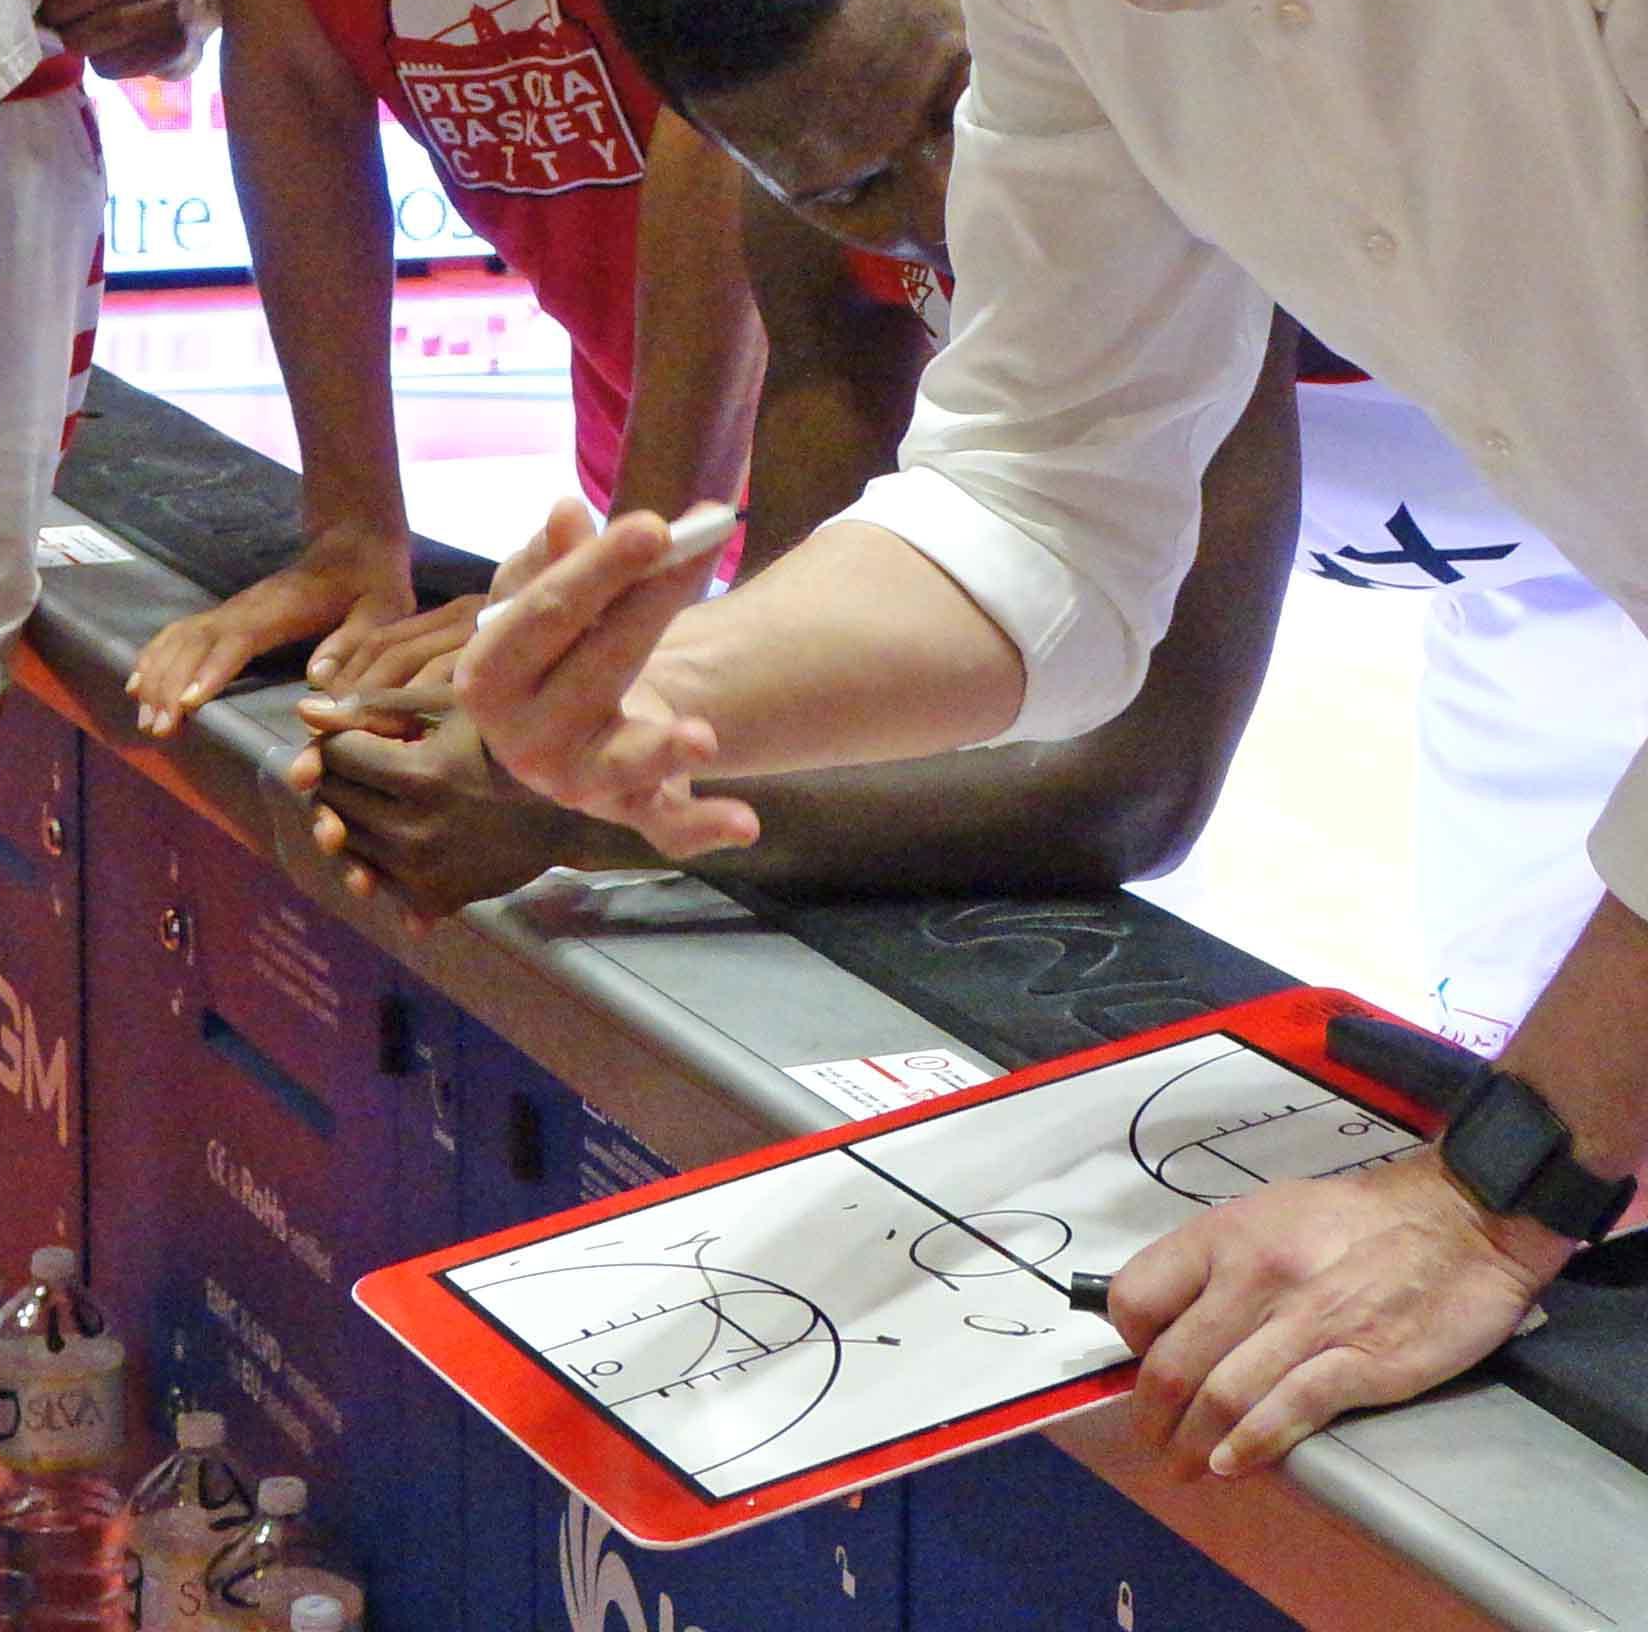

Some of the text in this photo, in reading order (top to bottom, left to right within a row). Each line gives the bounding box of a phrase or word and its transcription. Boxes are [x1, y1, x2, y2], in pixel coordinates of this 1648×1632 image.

[412, 68, 599, 114] PISTOIA
[430, 99, 605, 148] BASKET
[449, 137, 618, 183] CITY
